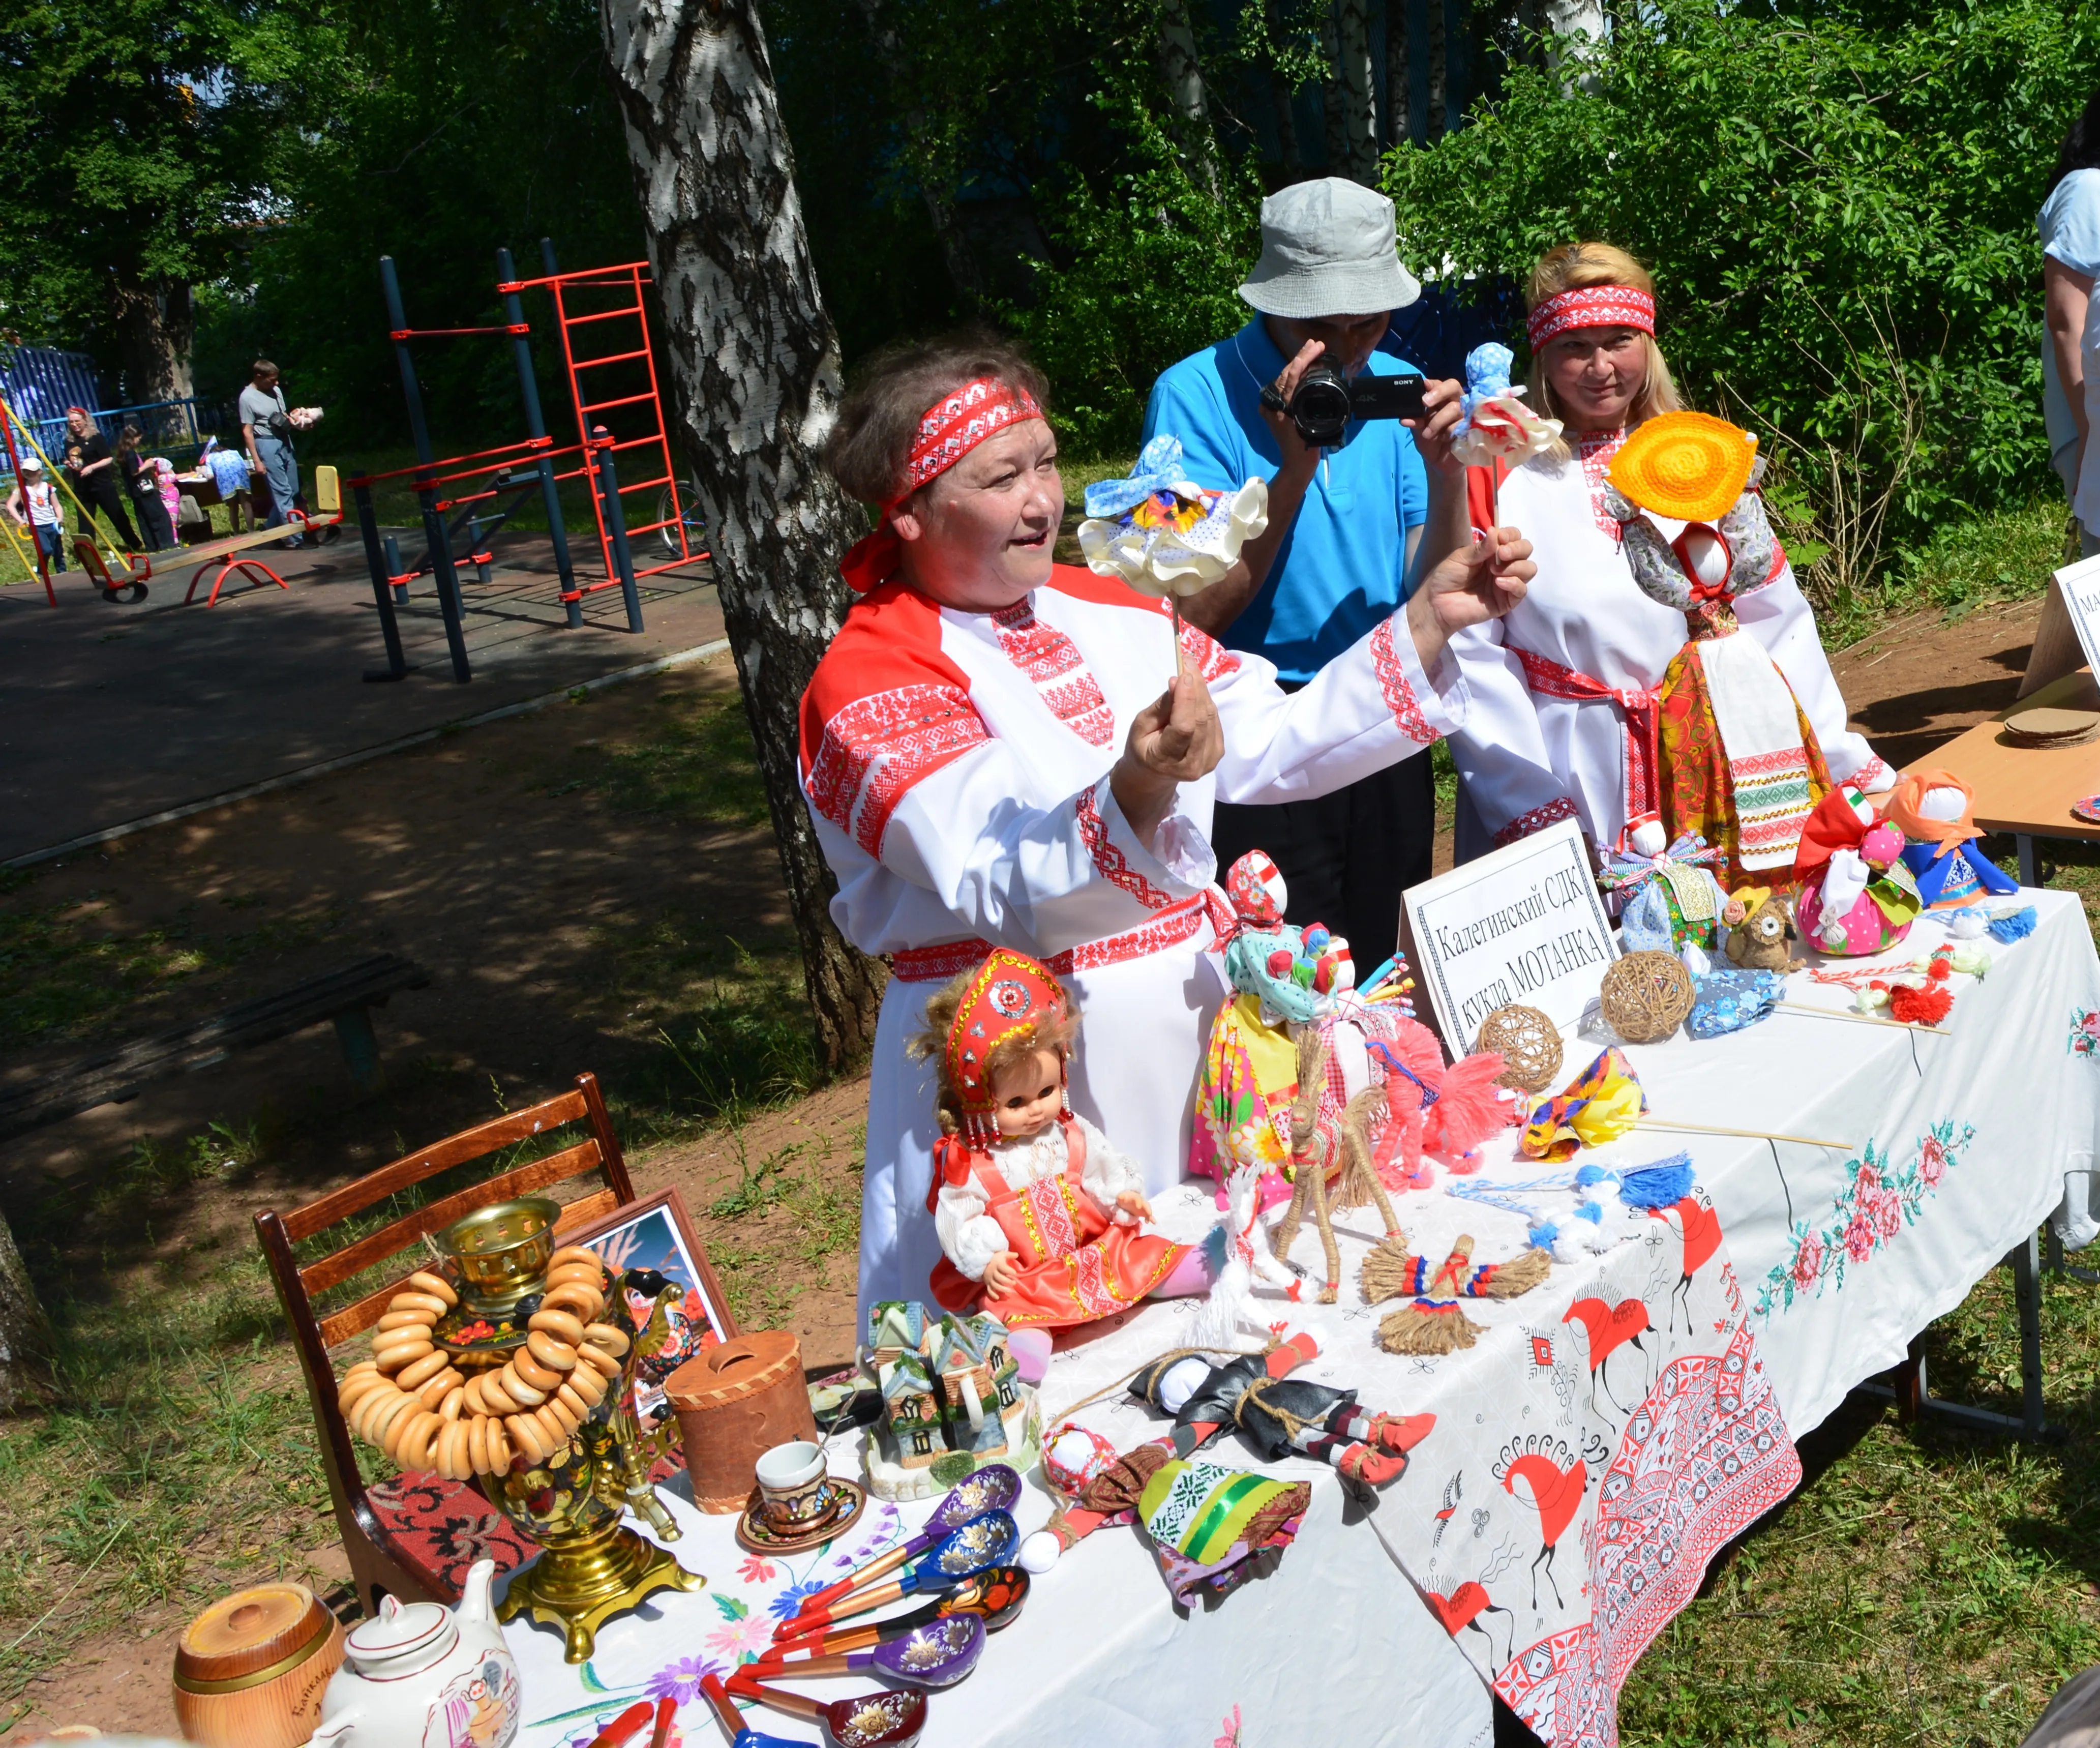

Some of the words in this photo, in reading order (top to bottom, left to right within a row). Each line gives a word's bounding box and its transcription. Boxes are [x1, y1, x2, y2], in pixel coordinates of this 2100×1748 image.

[1356, 393, 1377, 402] 4K
[2079, 589, 2100, 615] МА
[1435, 884, 1547, 962] Калегинский
[1545, 866, 1583, 913] СДК
[1461, 979, 1512, 1031] кукла
[1505, 926, 1606, 998] МОТАНКА
